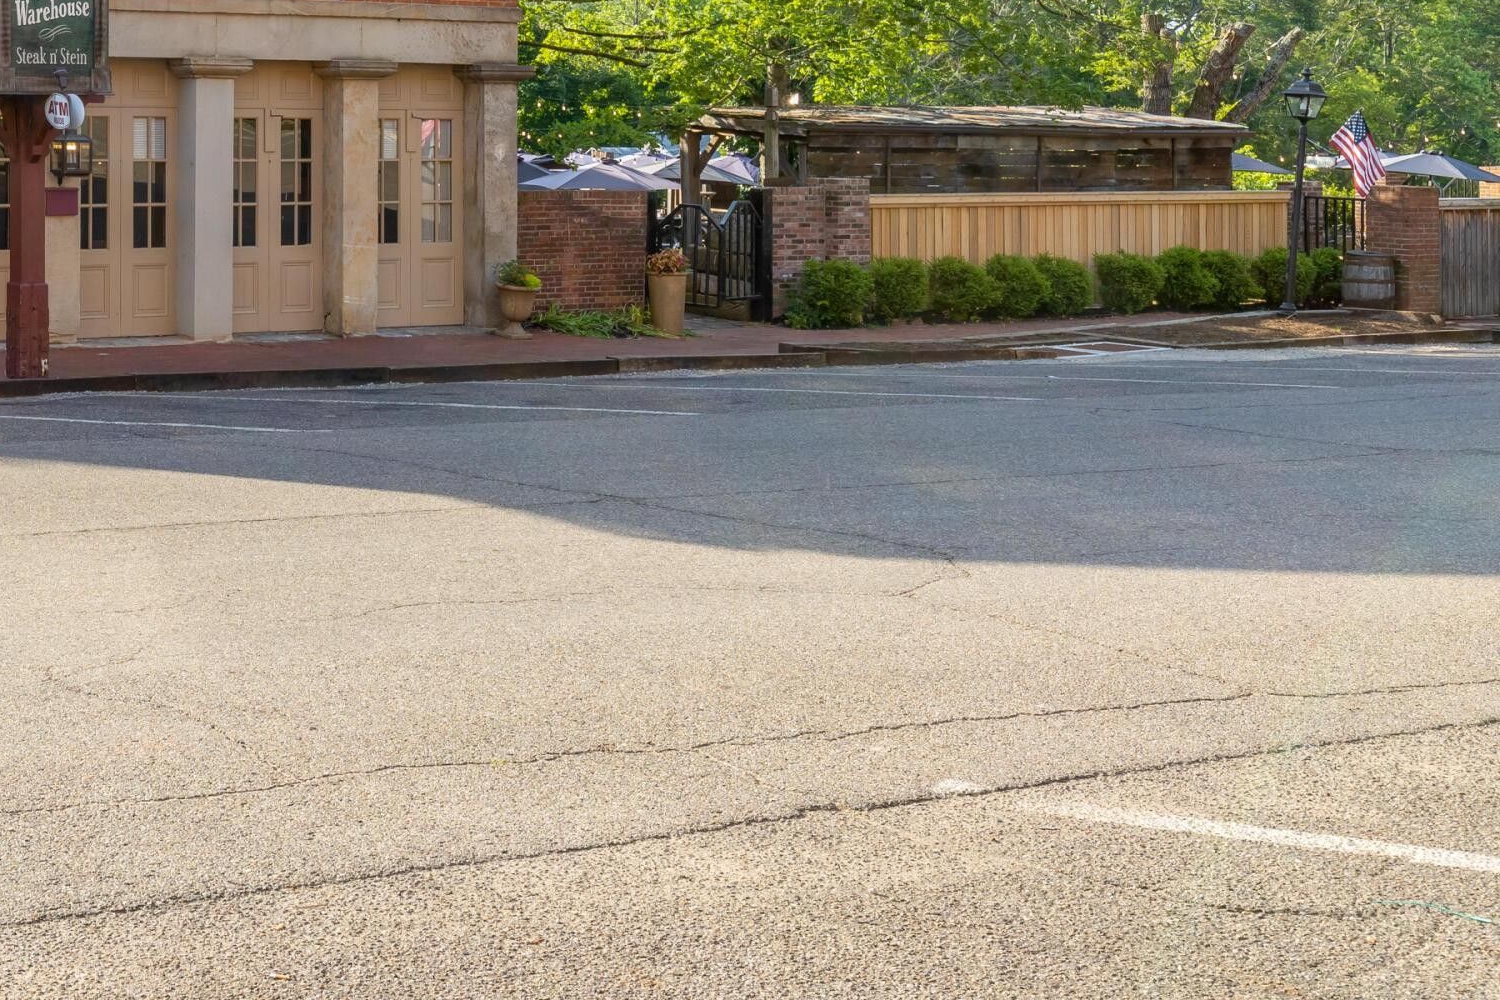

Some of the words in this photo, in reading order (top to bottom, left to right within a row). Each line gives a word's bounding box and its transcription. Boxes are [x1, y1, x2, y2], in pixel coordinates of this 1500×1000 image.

[16, 46, 47, 65] Steak
[49, 48, 58, 65] n'
[60, 47, 88, 65] Stein
[48, 100, 69, 117] ATM
